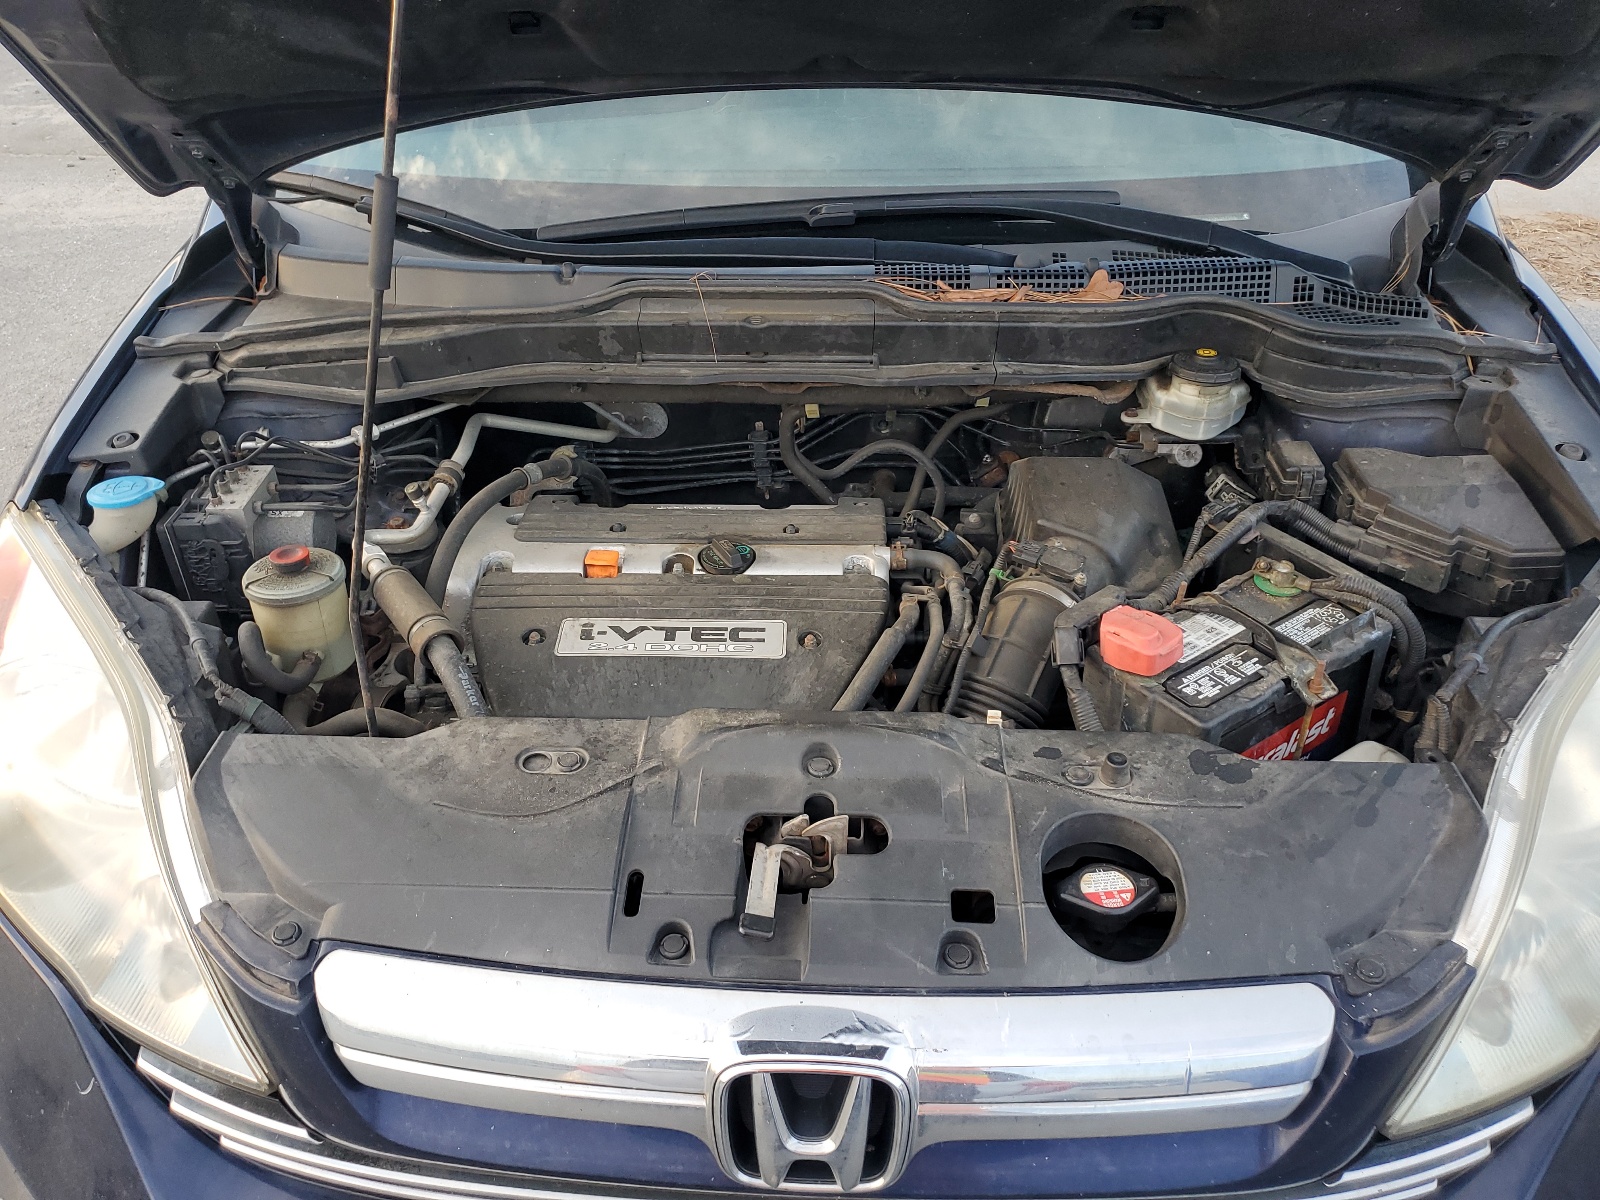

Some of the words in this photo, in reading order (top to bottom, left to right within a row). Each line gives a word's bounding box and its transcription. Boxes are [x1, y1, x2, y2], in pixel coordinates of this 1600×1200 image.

[579, 622, 766, 643] i-VTEC
[587, 642, 638, 651] 2.4
[645, 643, 754, 653] DOHC
